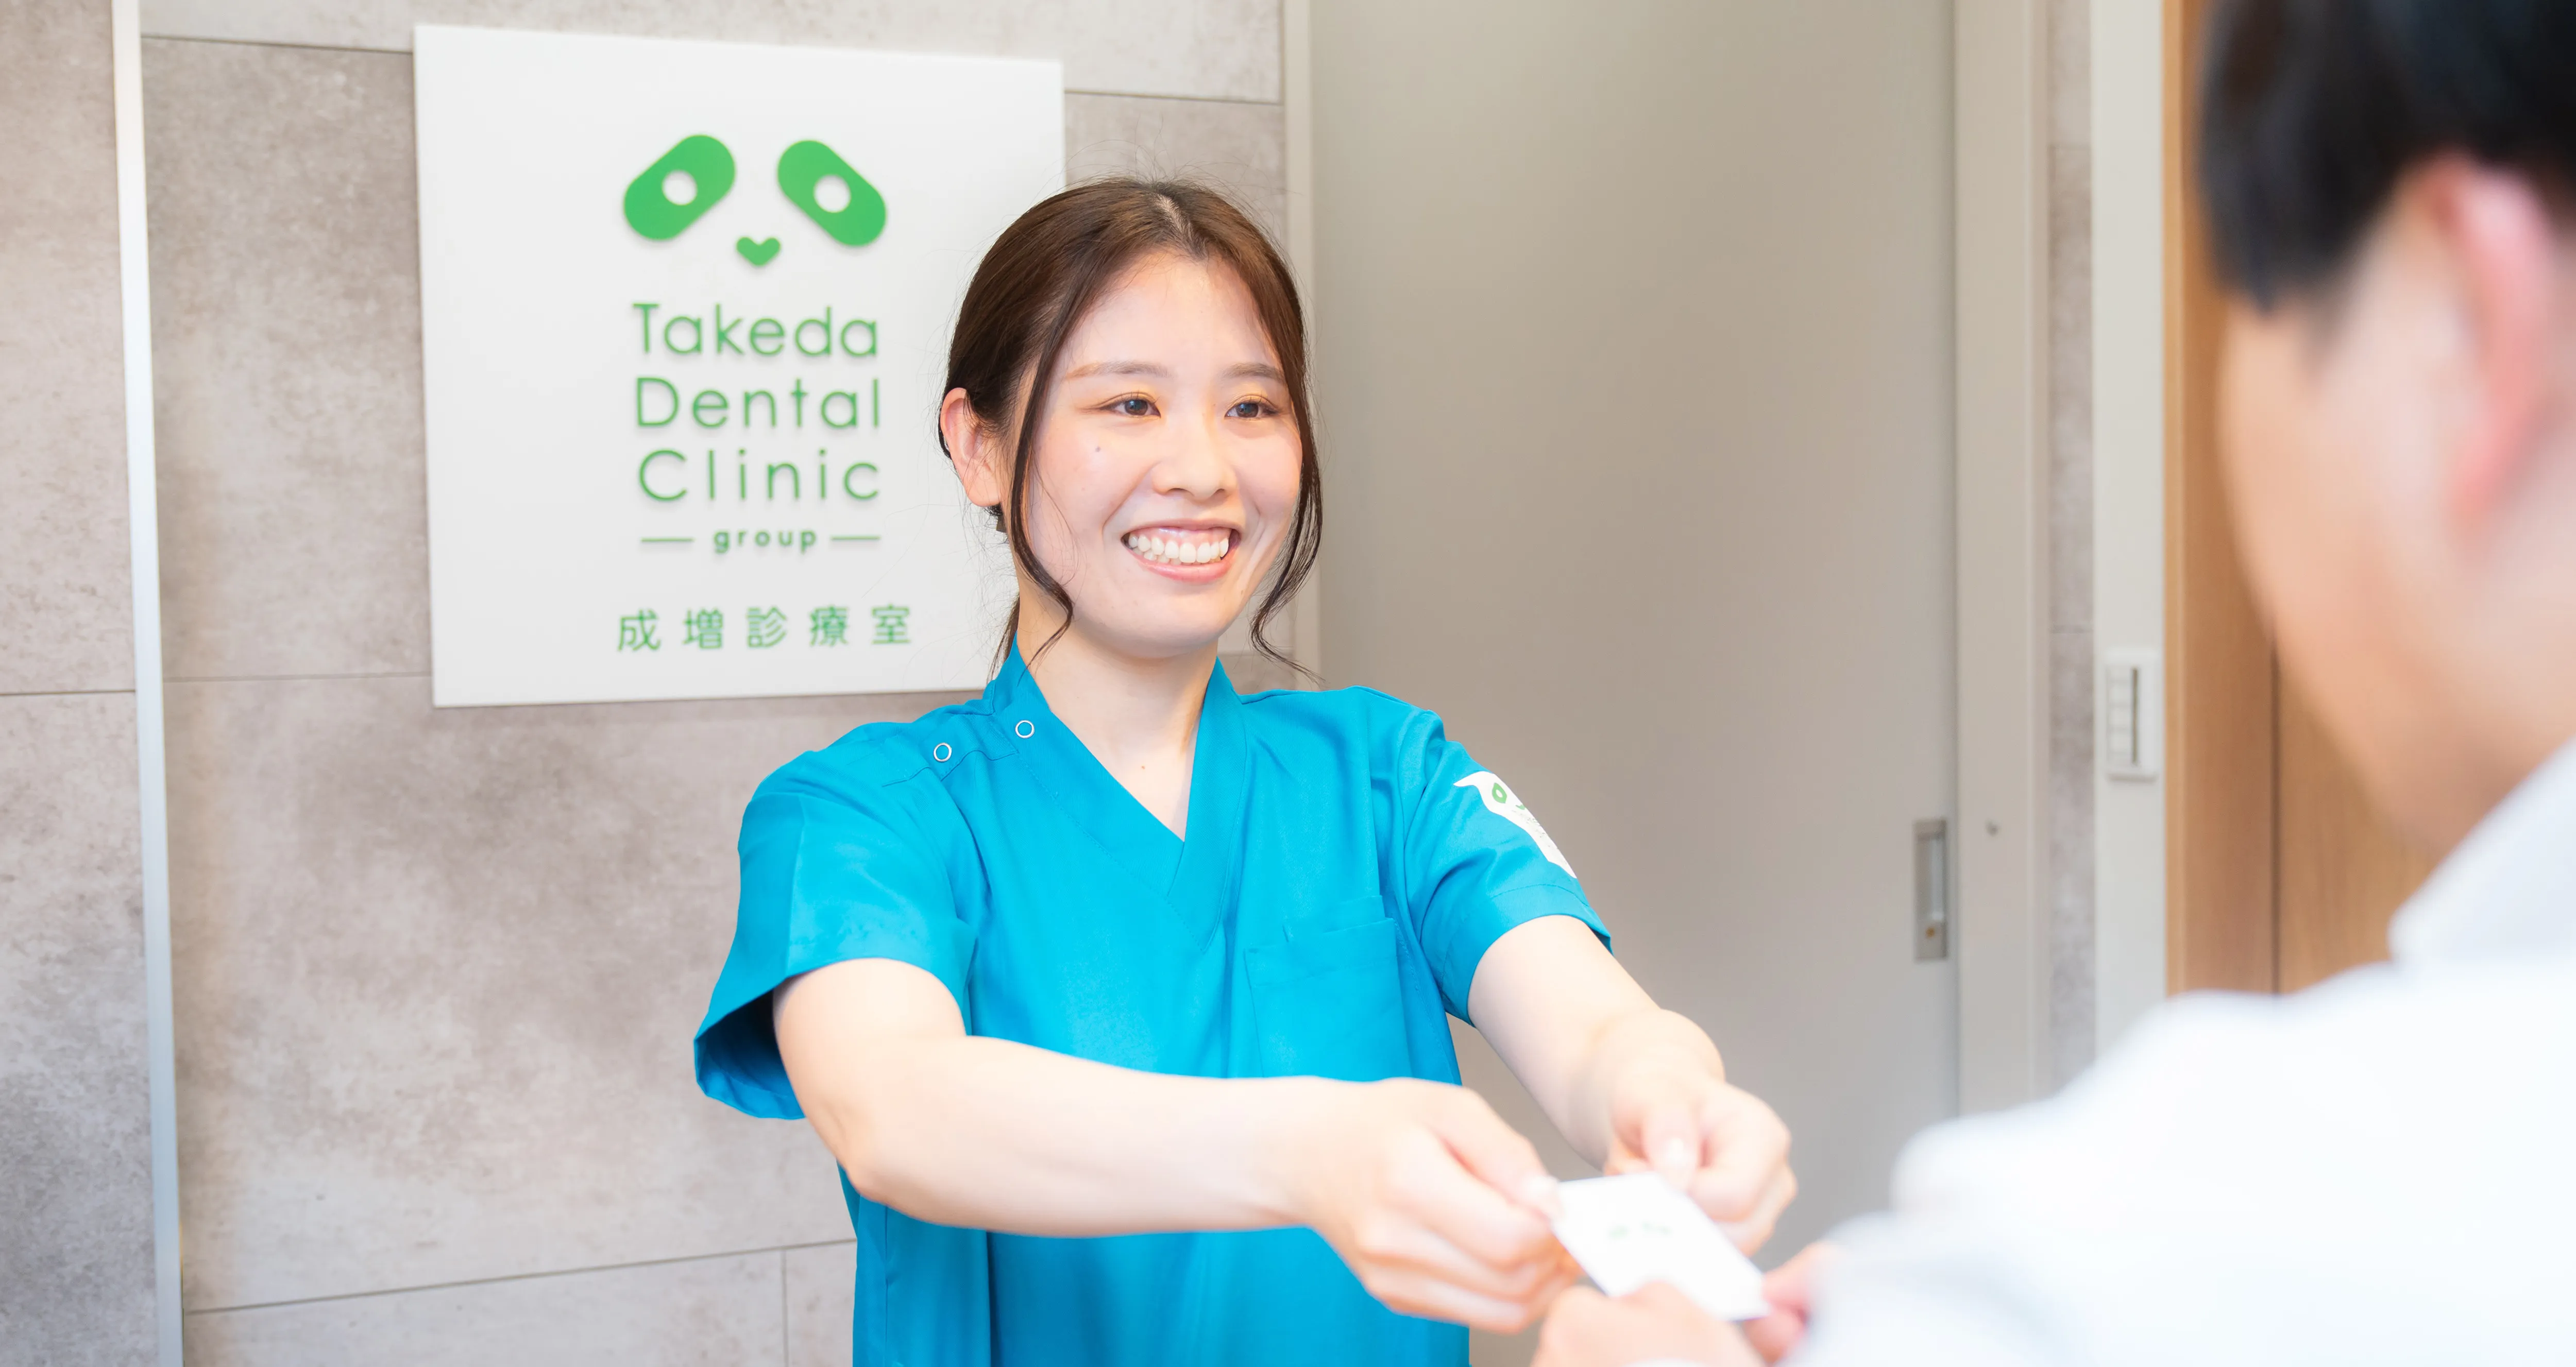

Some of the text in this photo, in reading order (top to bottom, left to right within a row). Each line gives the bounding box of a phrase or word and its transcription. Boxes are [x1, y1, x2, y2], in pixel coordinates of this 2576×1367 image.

[633, 303, 877, 356] Takeda
[637, 377, 878, 428] Dental
[639, 449, 878, 501] Clinic
[714, 529, 816, 554] group
[618, 604, 912, 652] 成増診療室
